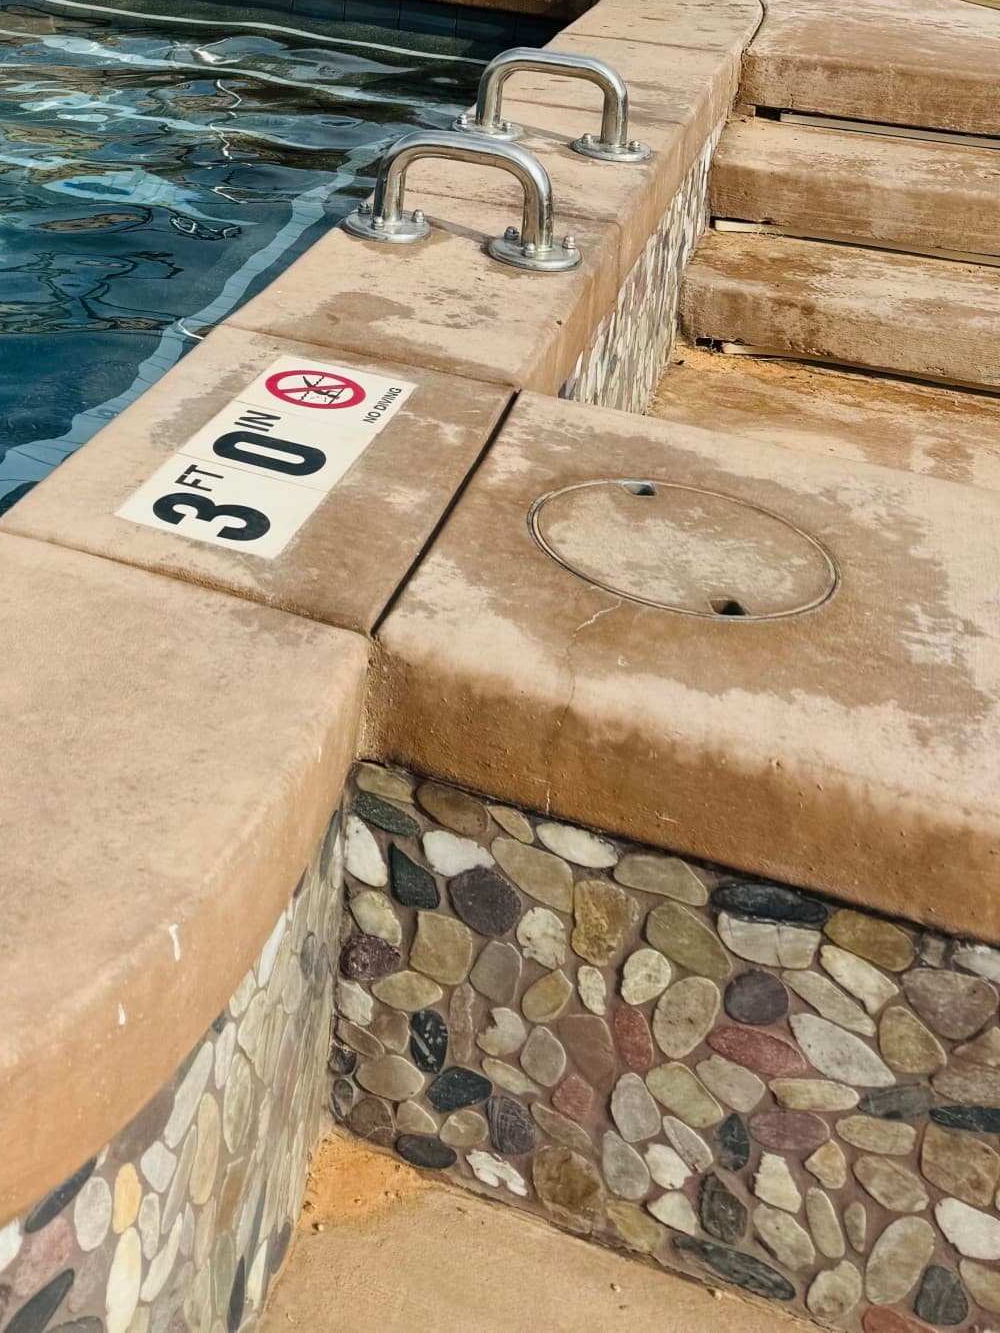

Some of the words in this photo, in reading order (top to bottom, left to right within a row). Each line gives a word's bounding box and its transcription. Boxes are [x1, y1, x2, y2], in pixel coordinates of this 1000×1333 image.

[234, 409, 281, 432] IN
[362, 411, 381, 424] NO
[373, 387, 402, 411] DIVING
[213, 430, 327, 476] 0
[174, 464, 224, 492] FT
[153, 492, 271, 541] 3
